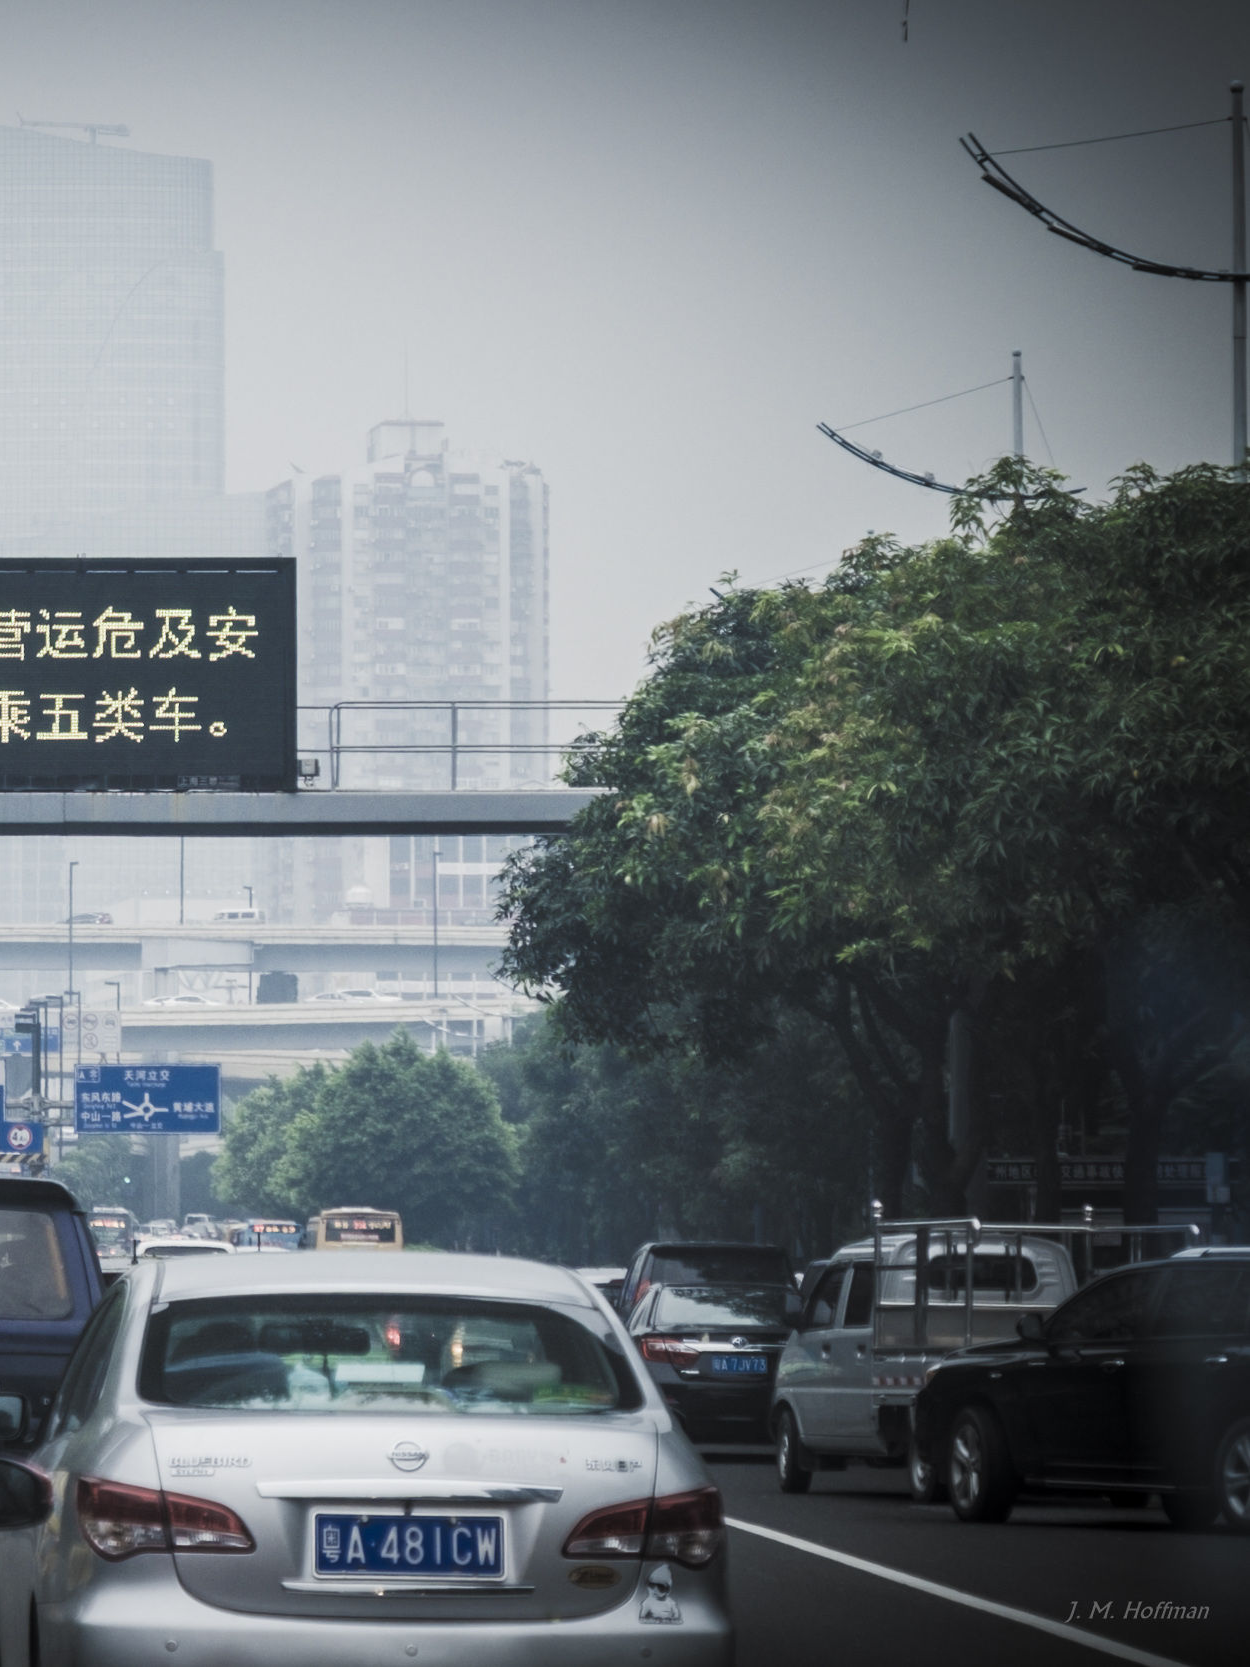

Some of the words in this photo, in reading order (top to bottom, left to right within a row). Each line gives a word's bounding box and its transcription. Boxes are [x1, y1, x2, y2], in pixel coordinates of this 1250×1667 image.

[124, 1069, 170, 1082] 天河立交
[80, 1110, 122, 1123] 中山一路
